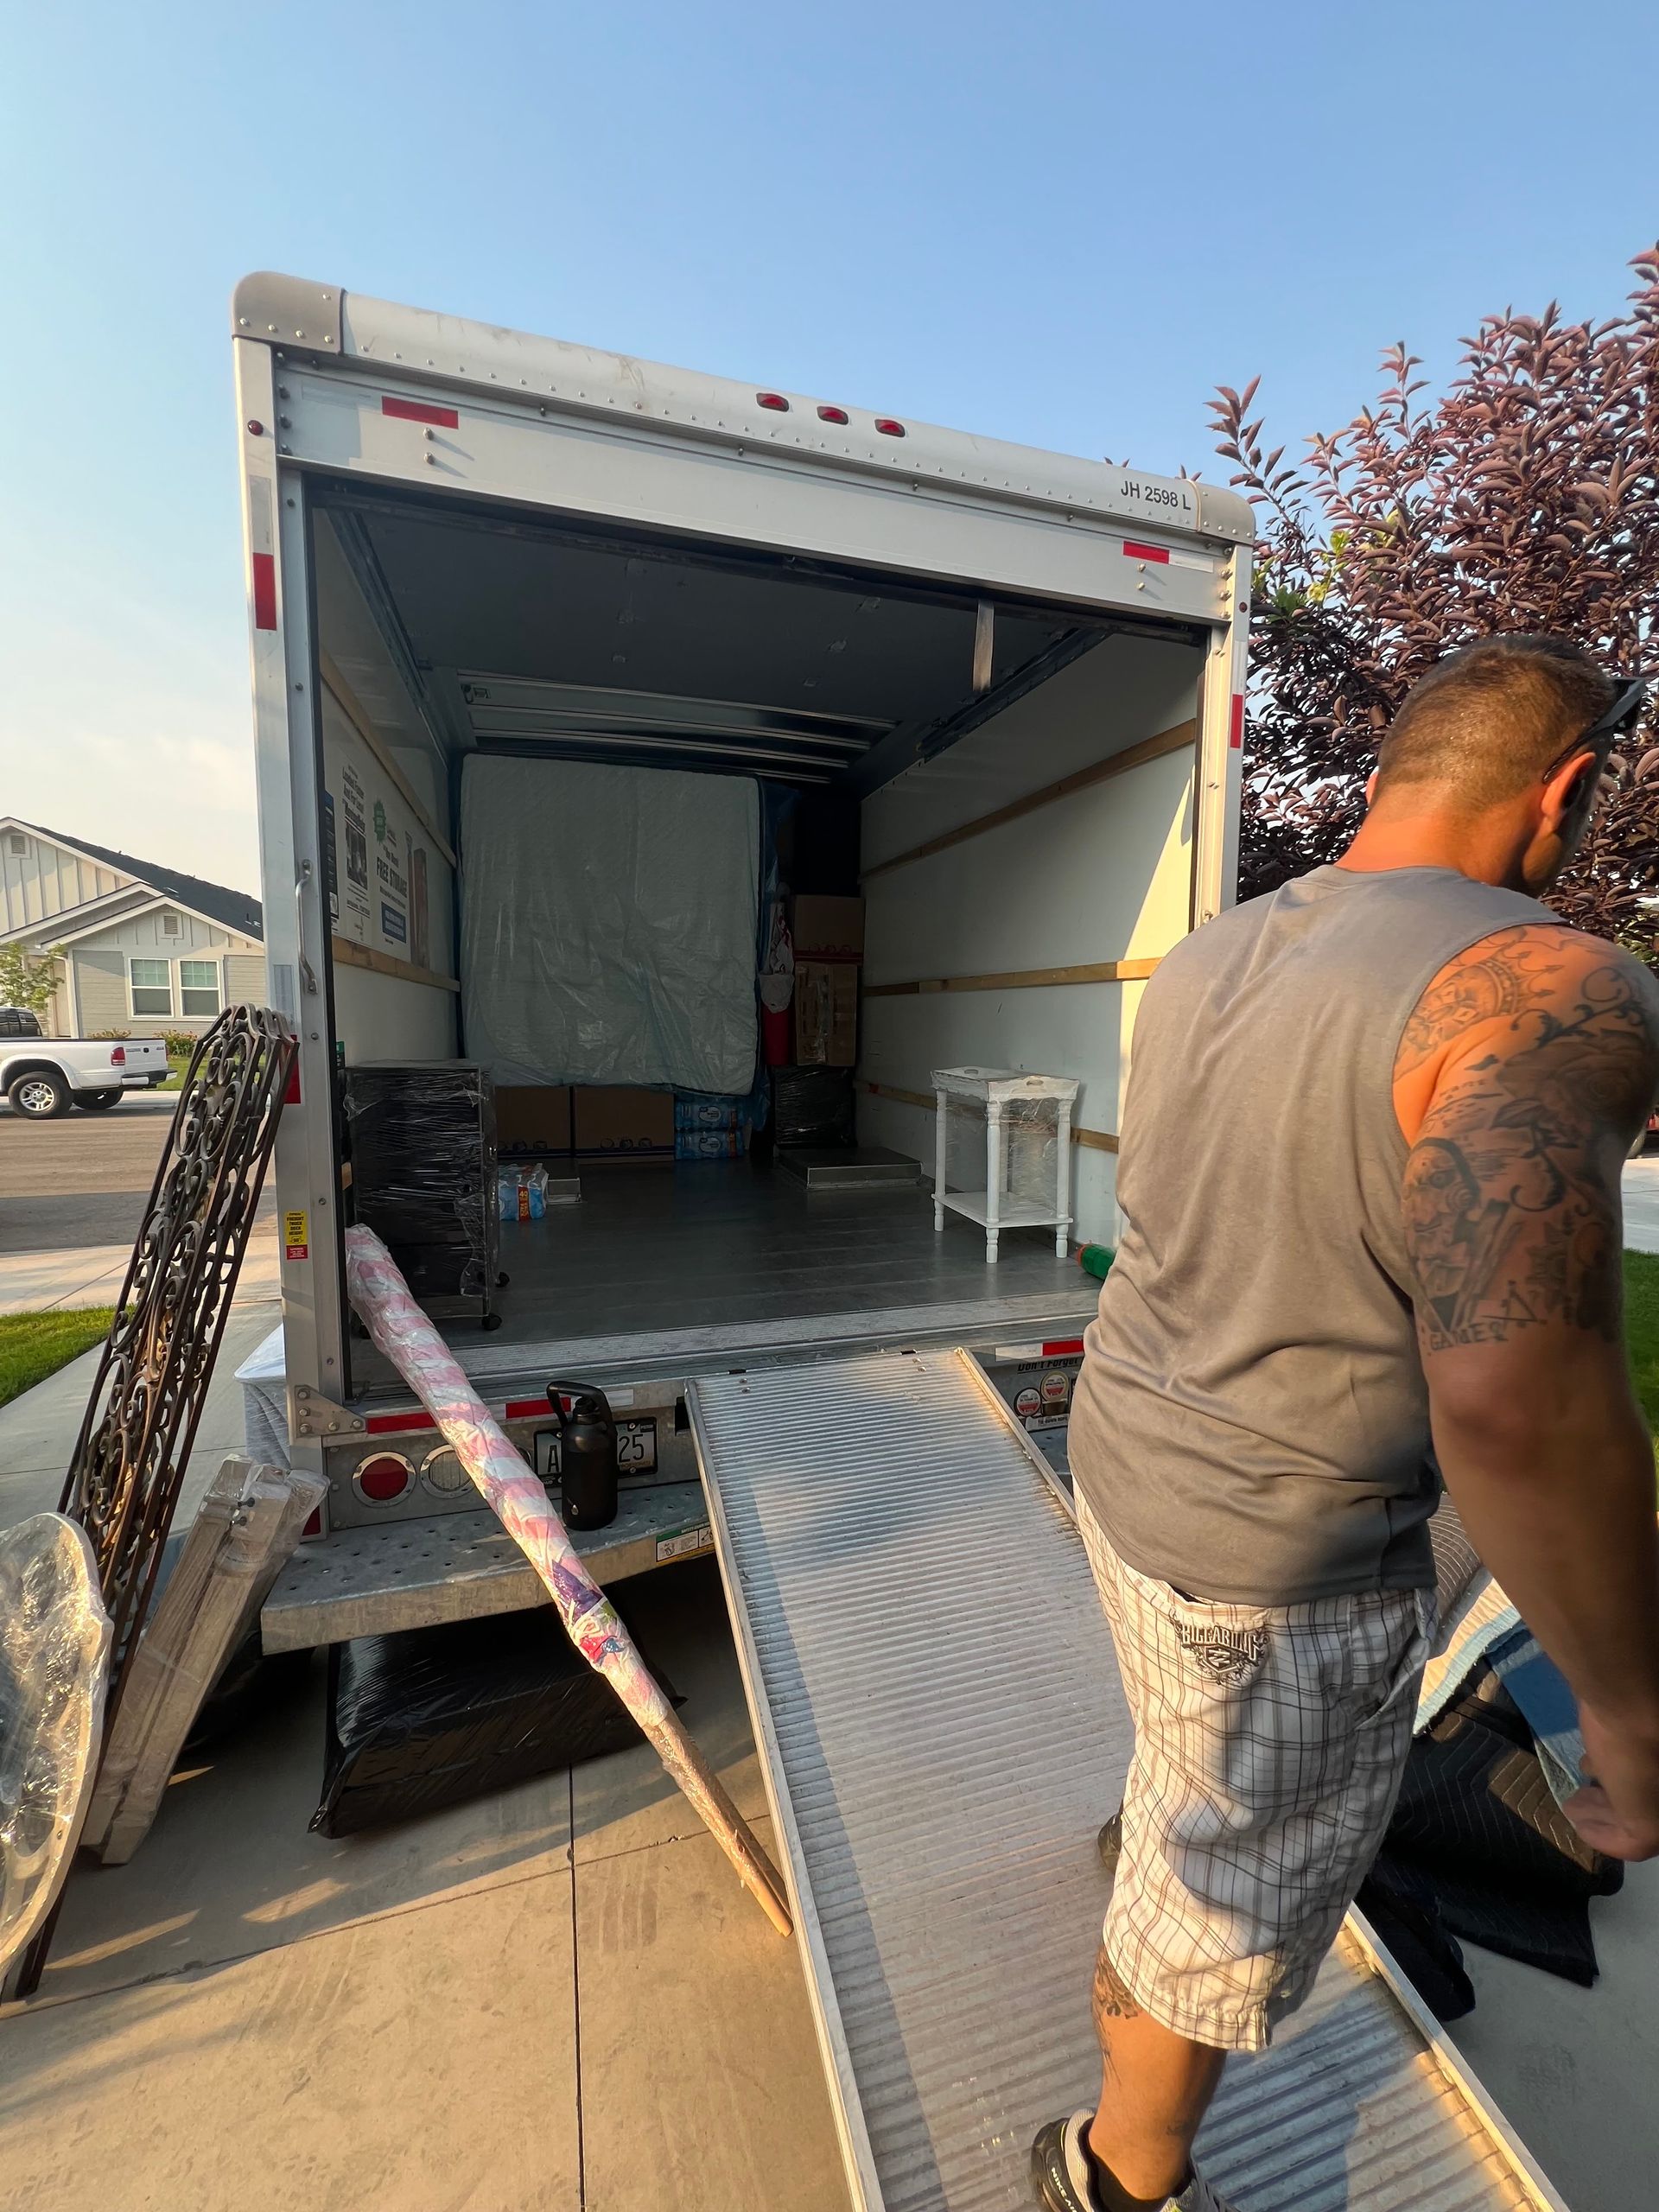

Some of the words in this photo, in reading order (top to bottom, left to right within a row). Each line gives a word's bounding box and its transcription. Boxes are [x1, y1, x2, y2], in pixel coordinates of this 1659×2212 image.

[1121, 480, 1140, 499] JH
[1145, 486, 1179, 507] 2598
[1183, 494, 1192, 510] L
[548, 1445, 559, 1472] A
[619, 1433, 644, 1463] 25
